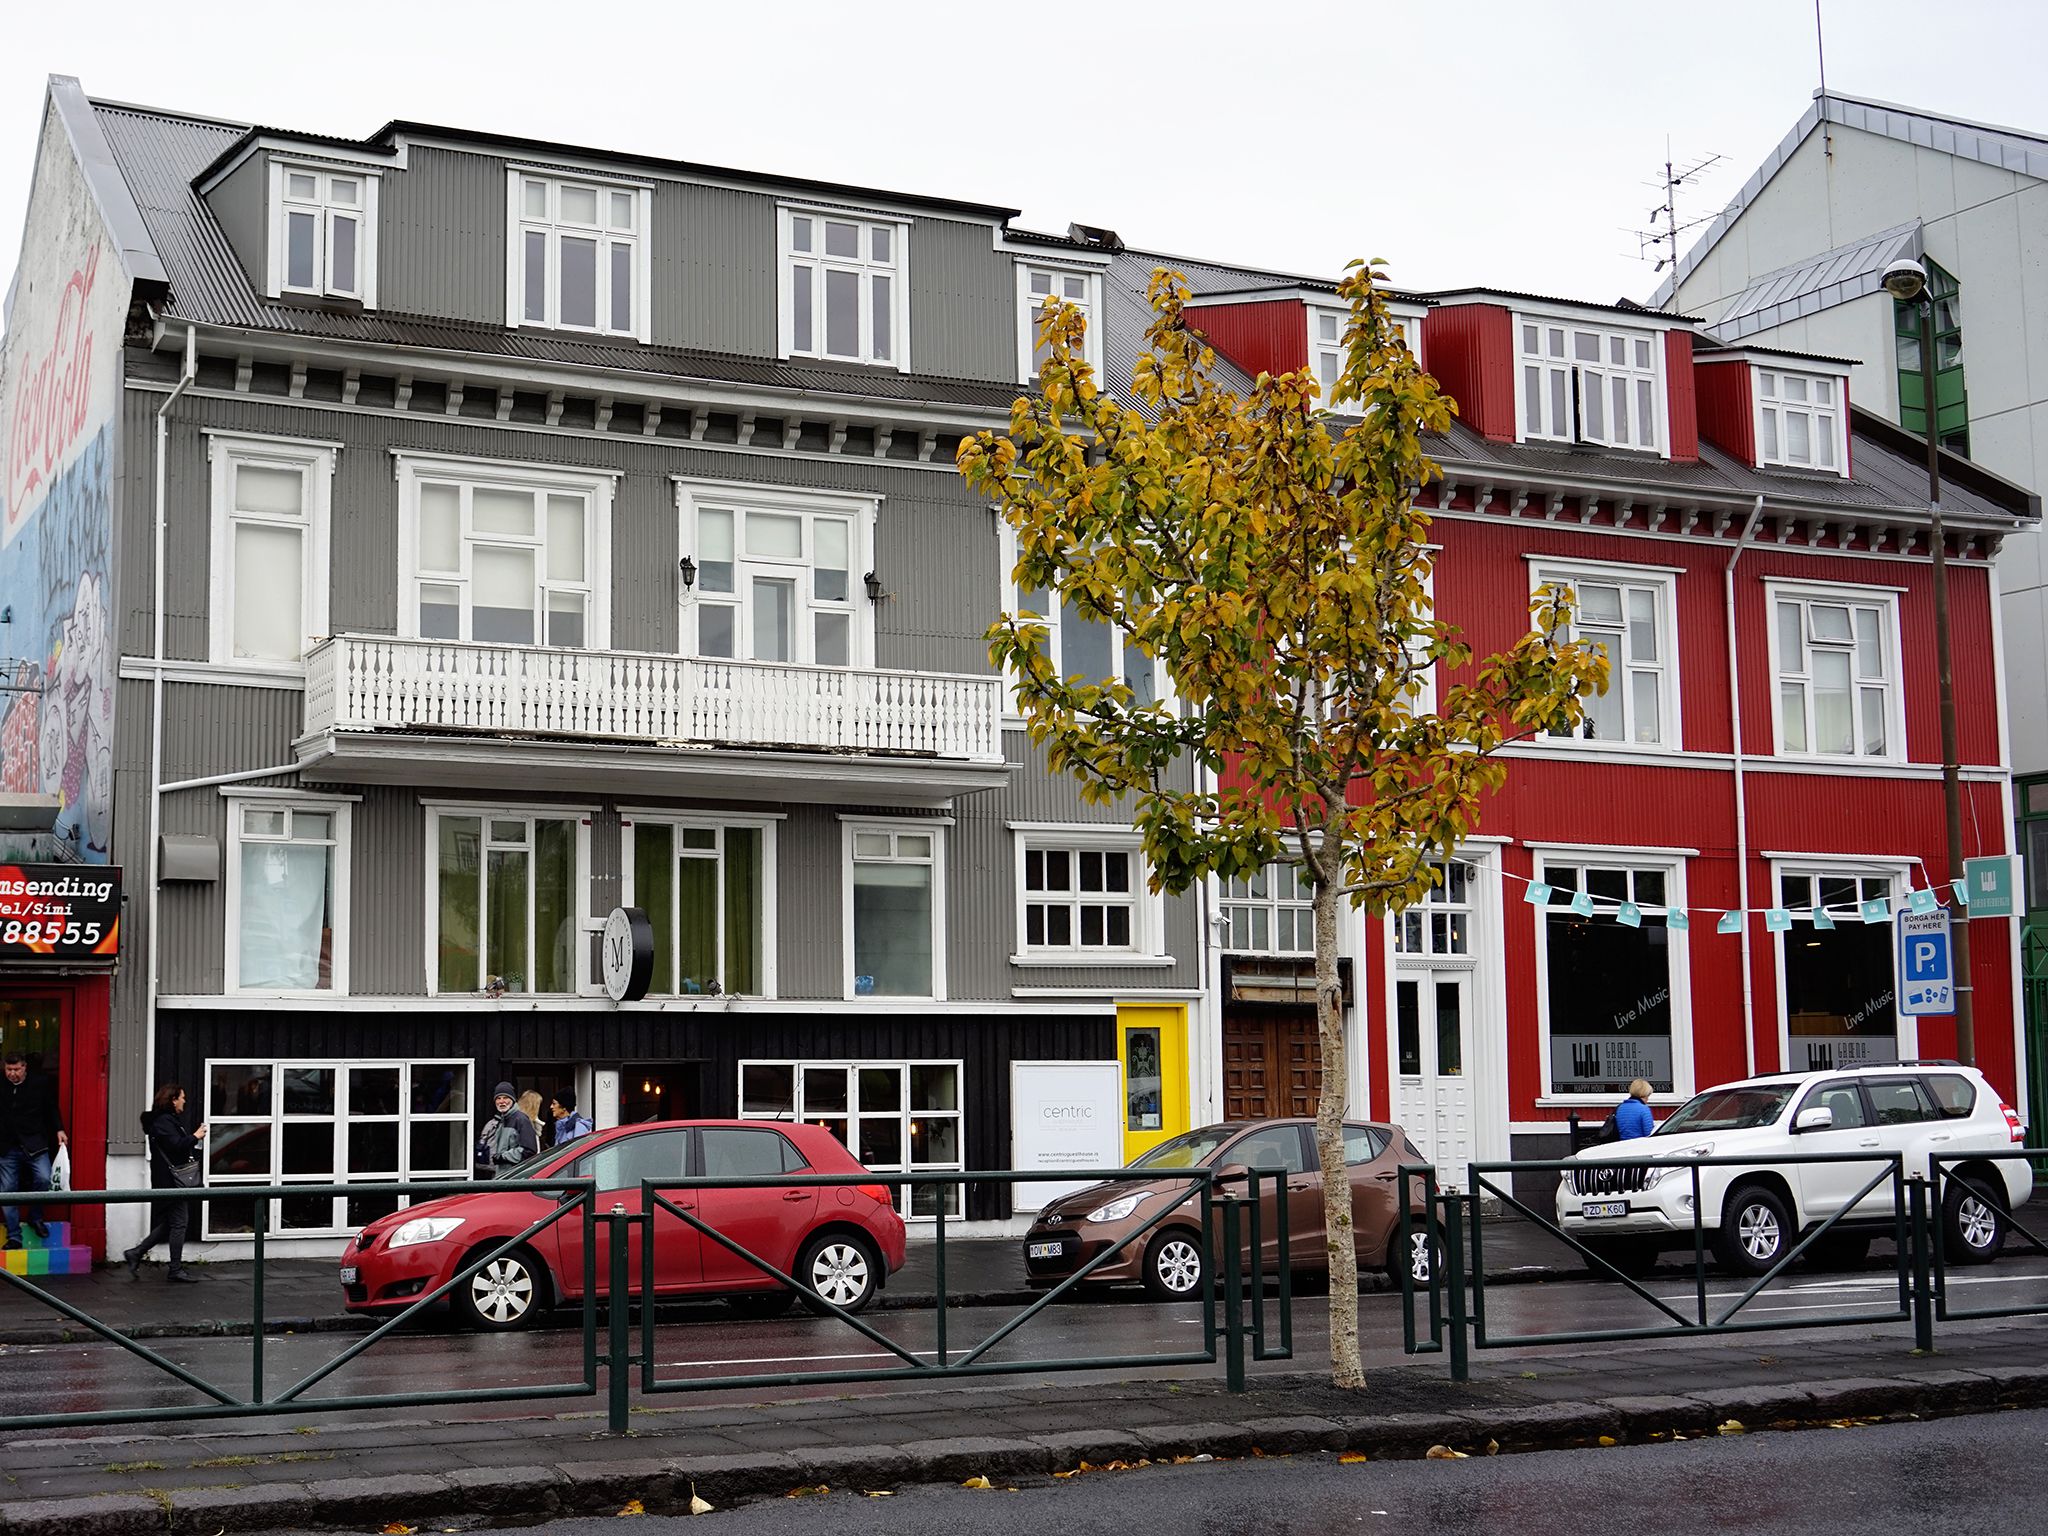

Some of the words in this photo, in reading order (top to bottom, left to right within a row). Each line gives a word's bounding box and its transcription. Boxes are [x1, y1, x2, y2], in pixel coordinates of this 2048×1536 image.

[0, 901, 73, 917] el/Sími
[1904, 914, 1929, 922] BORGA
[0, 920, 101, 944] 88555
[1915, 942, 1936, 973] P
[1930, 963, 1935, 972] 1
[1614, 1010, 1637, 1029] Live
[1637, 986, 1669, 1015] Music
[1843, 1012, 1865, 1030] Live
[1864, 989, 1894, 1016] Music
[1043, 1105, 1092, 1118] centric
[1590, 1205, 1602, 1215] ZD
[1607, 1204, 1624, 1214] K60
